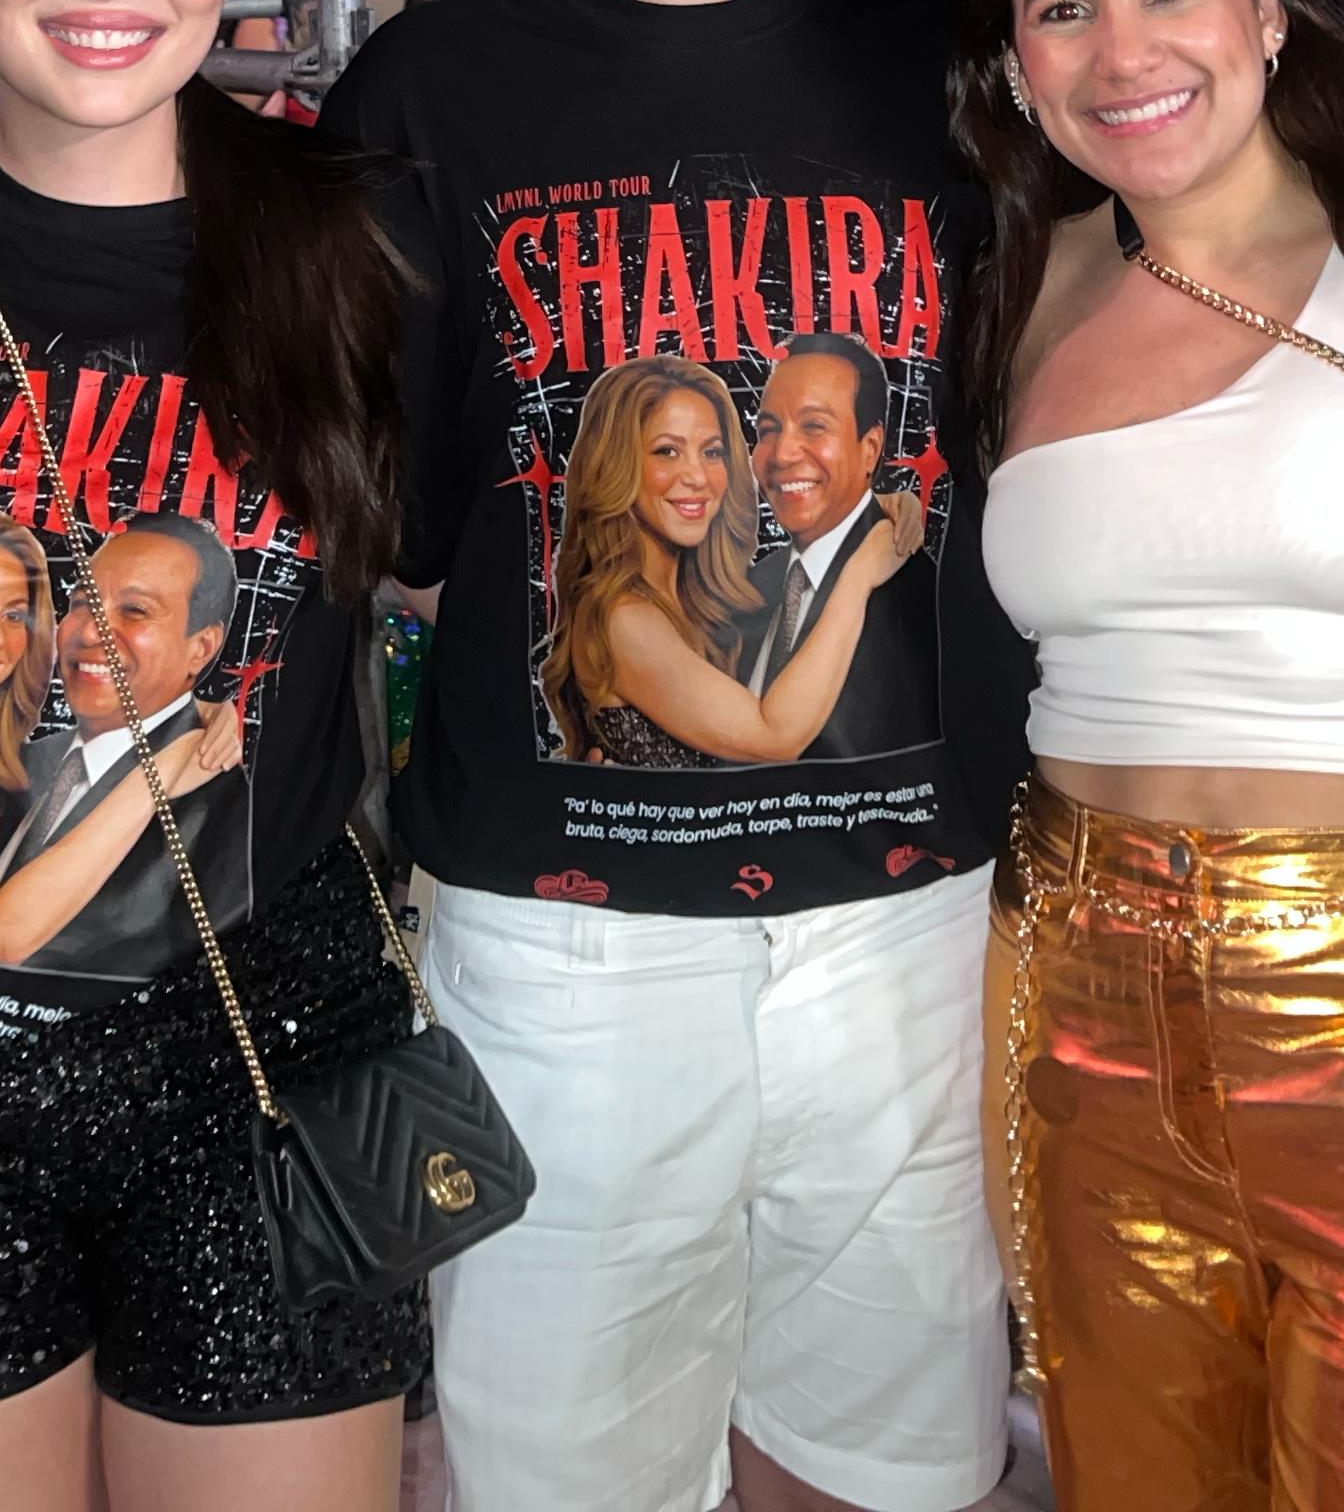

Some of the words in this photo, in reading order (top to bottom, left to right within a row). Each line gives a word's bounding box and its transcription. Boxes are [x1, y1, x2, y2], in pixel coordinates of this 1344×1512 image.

[496, 188, 542, 214] LMYNL
[548, 180, 603, 205] WORLD
[608, 175, 652, 199] TOUR
[496, 195, 943, 381] SHAKIRA
[591, 799, 605, 815] lo
[607, 800, 636, 821] qué
[638, 801, 667, 823] hay
[667, 806, 696, 824] que
[699, 804, 725, 820] ver
[726, 800, 757, 817] hoy
[759, 797, 780, 811] en
[816, 791, 862, 811] mejor
[863, 790, 883, 803] es
[565, 820, 605, 840] bruta,
[608, 824, 648, 845] ciega,
[651, 821, 744, 844] sordomuda,
[748, 817, 793, 836] torpe,
[796, 813, 844, 828] traste
[846, 814, 856, 832] y
